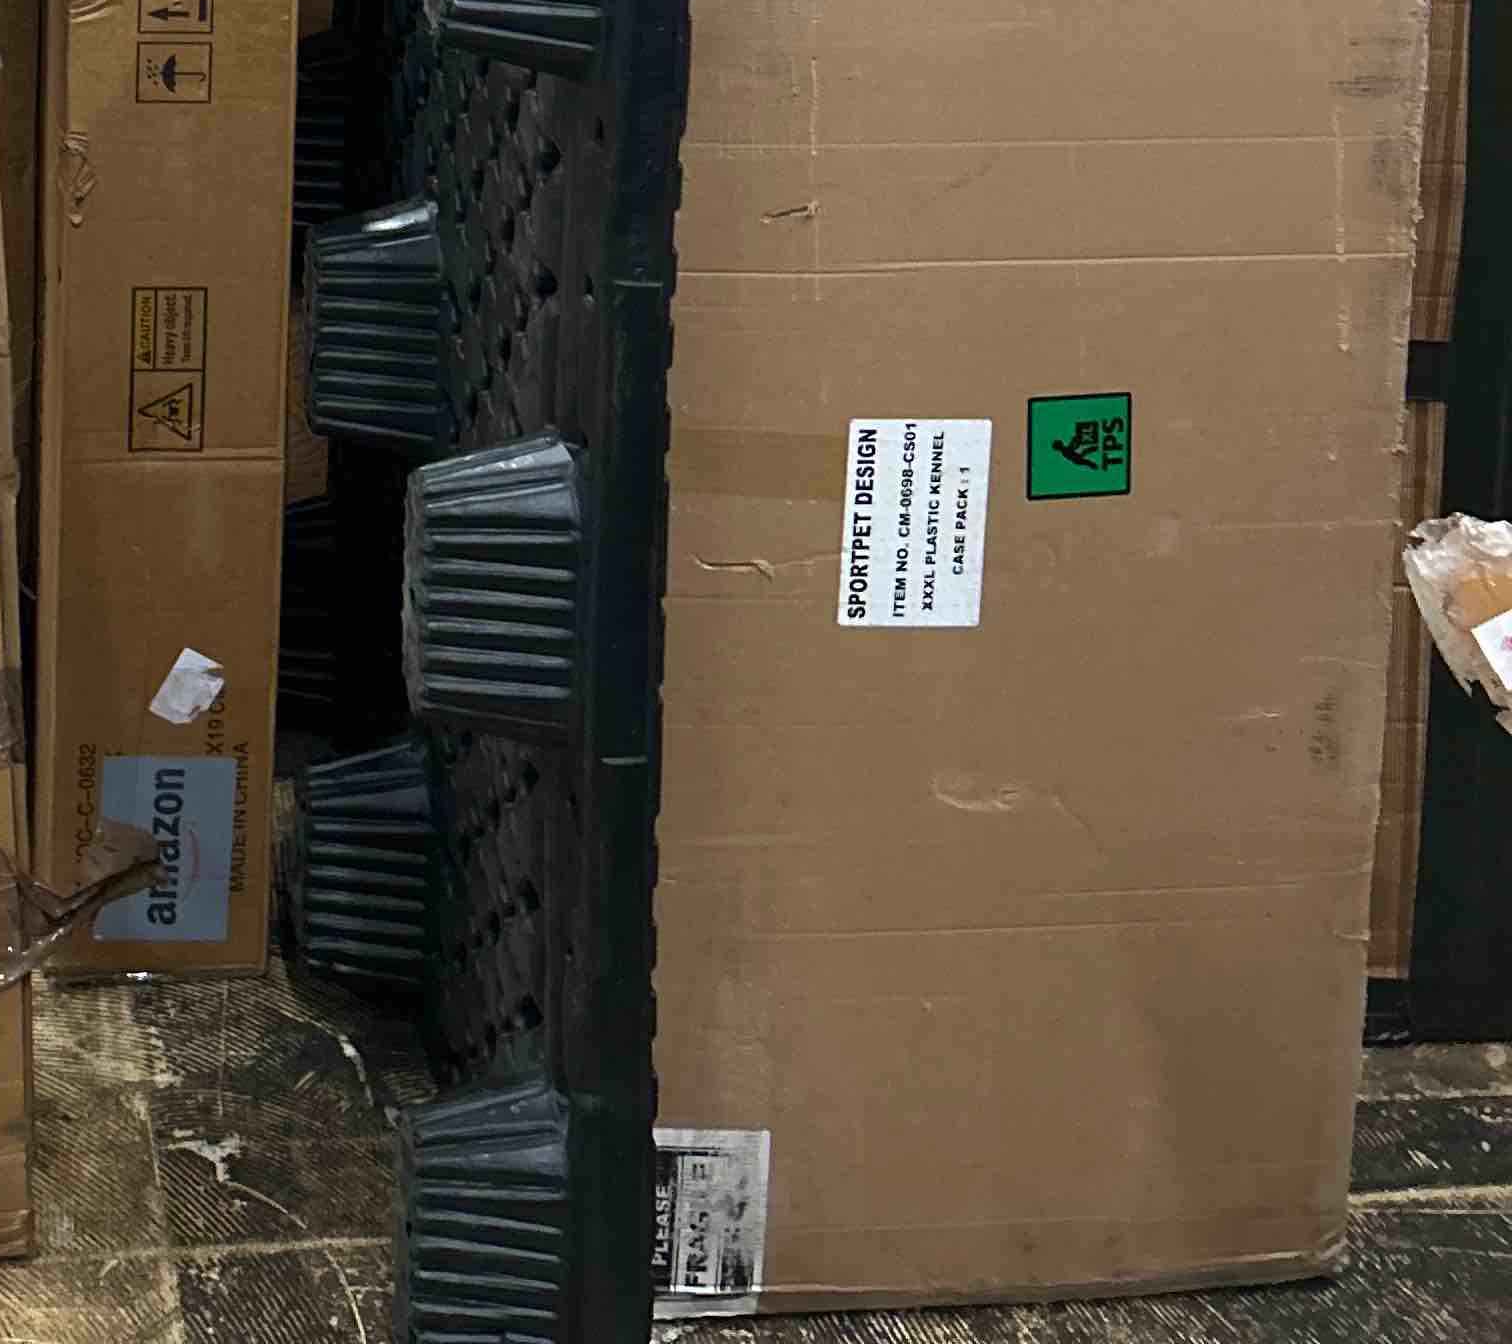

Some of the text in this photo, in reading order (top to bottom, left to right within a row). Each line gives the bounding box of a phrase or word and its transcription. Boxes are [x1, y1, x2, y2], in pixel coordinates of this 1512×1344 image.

[138, 296, 153, 351] CAUTION
[160, 331, 178, 366] Heavy
[1101, 416, 1125, 472] TPS
[847, 428, 877, 619] SPORTPET DESIGN
[892, 422, 917, 618] ITEM NO. CM-0698-CS01
[921, 431, 945, 611] XXXL PLASTIC KENNEL
[955, 488, 969, 530] PACK
[952, 535, 966, 575] CASE
[206, 718, 224, 755] X19
[232, 809, 248, 830] IN
[229, 833, 248, 893] MADE
[652, 1183, 671, 1266] PLEASE
[685, 1161, 710, 1288] FRAGE
